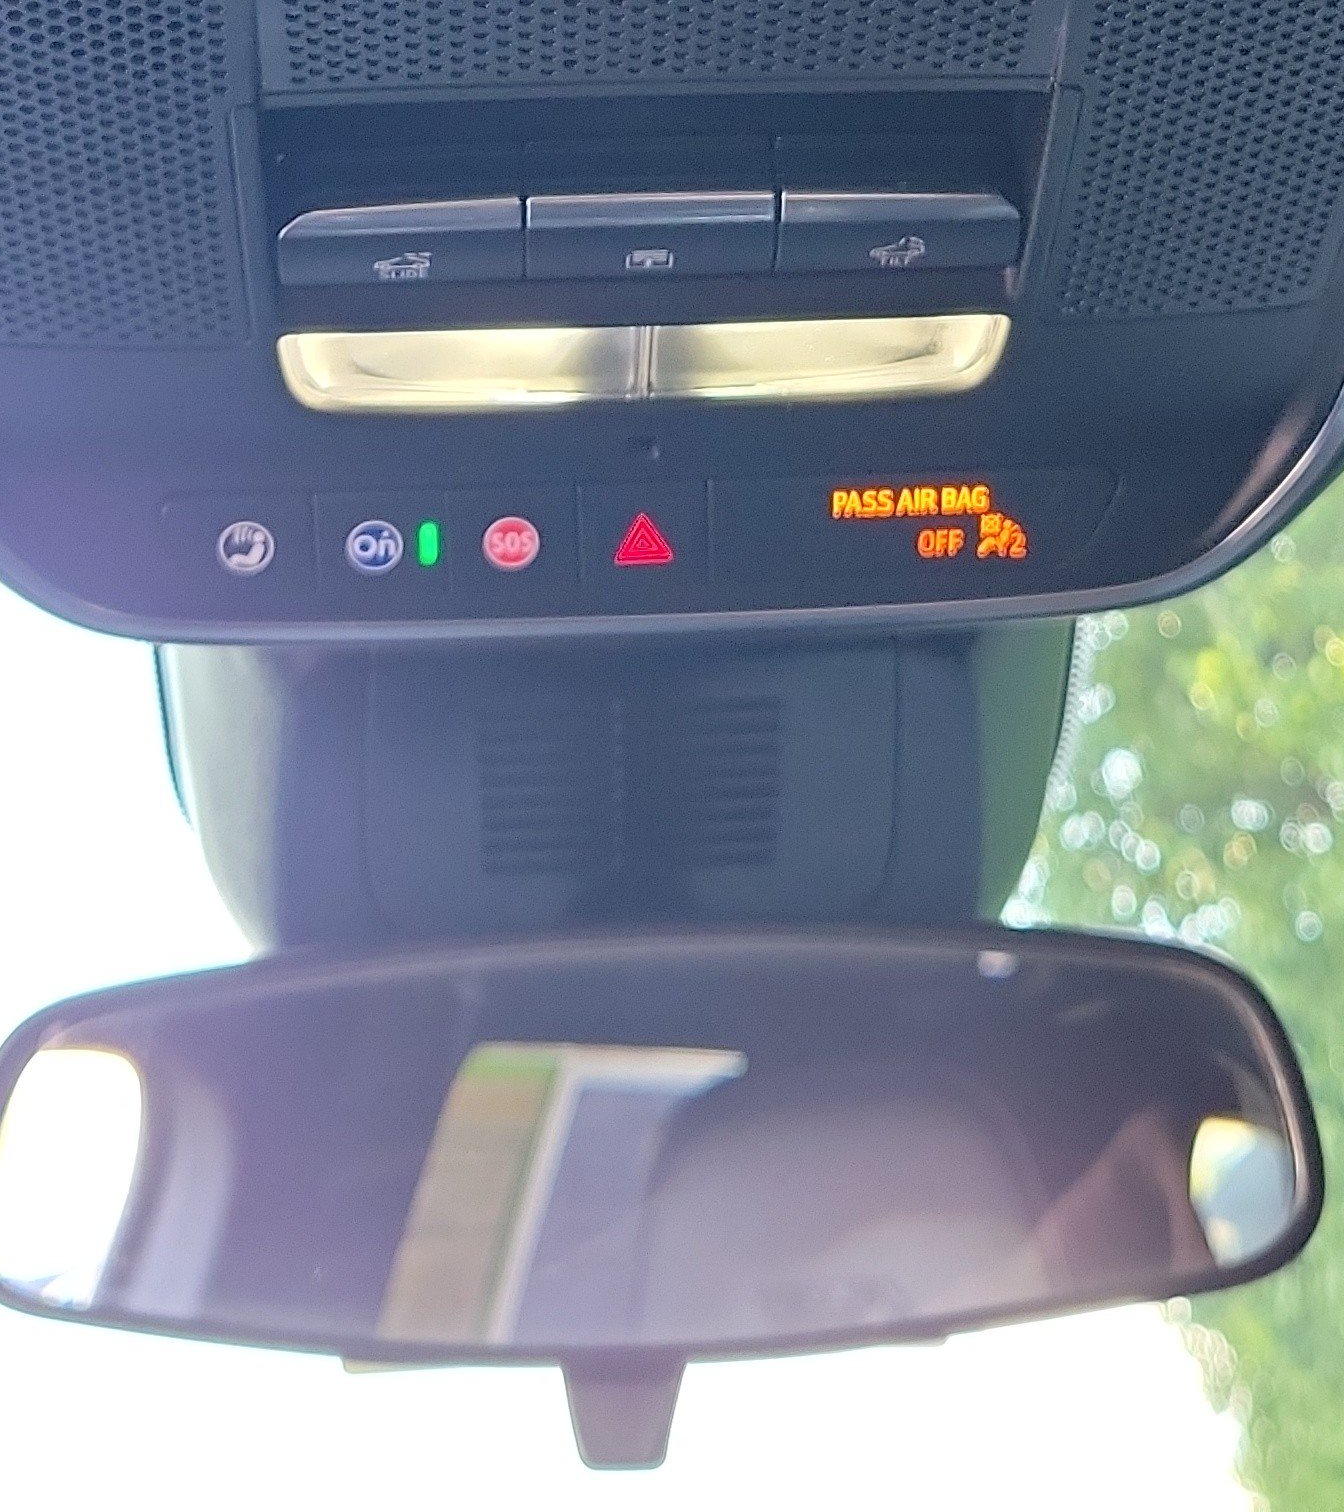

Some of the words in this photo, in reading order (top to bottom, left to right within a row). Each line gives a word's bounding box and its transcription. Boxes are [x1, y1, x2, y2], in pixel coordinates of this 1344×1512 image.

[832, 490, 895, 519] PASS
[896, 487, 939, 517] AIR
[941, 485, 990, 515] BAG
[355, 531, 396, 559] On
[489, 531, 533, 554] SOS
[917, 528, 966, 558] OFF
